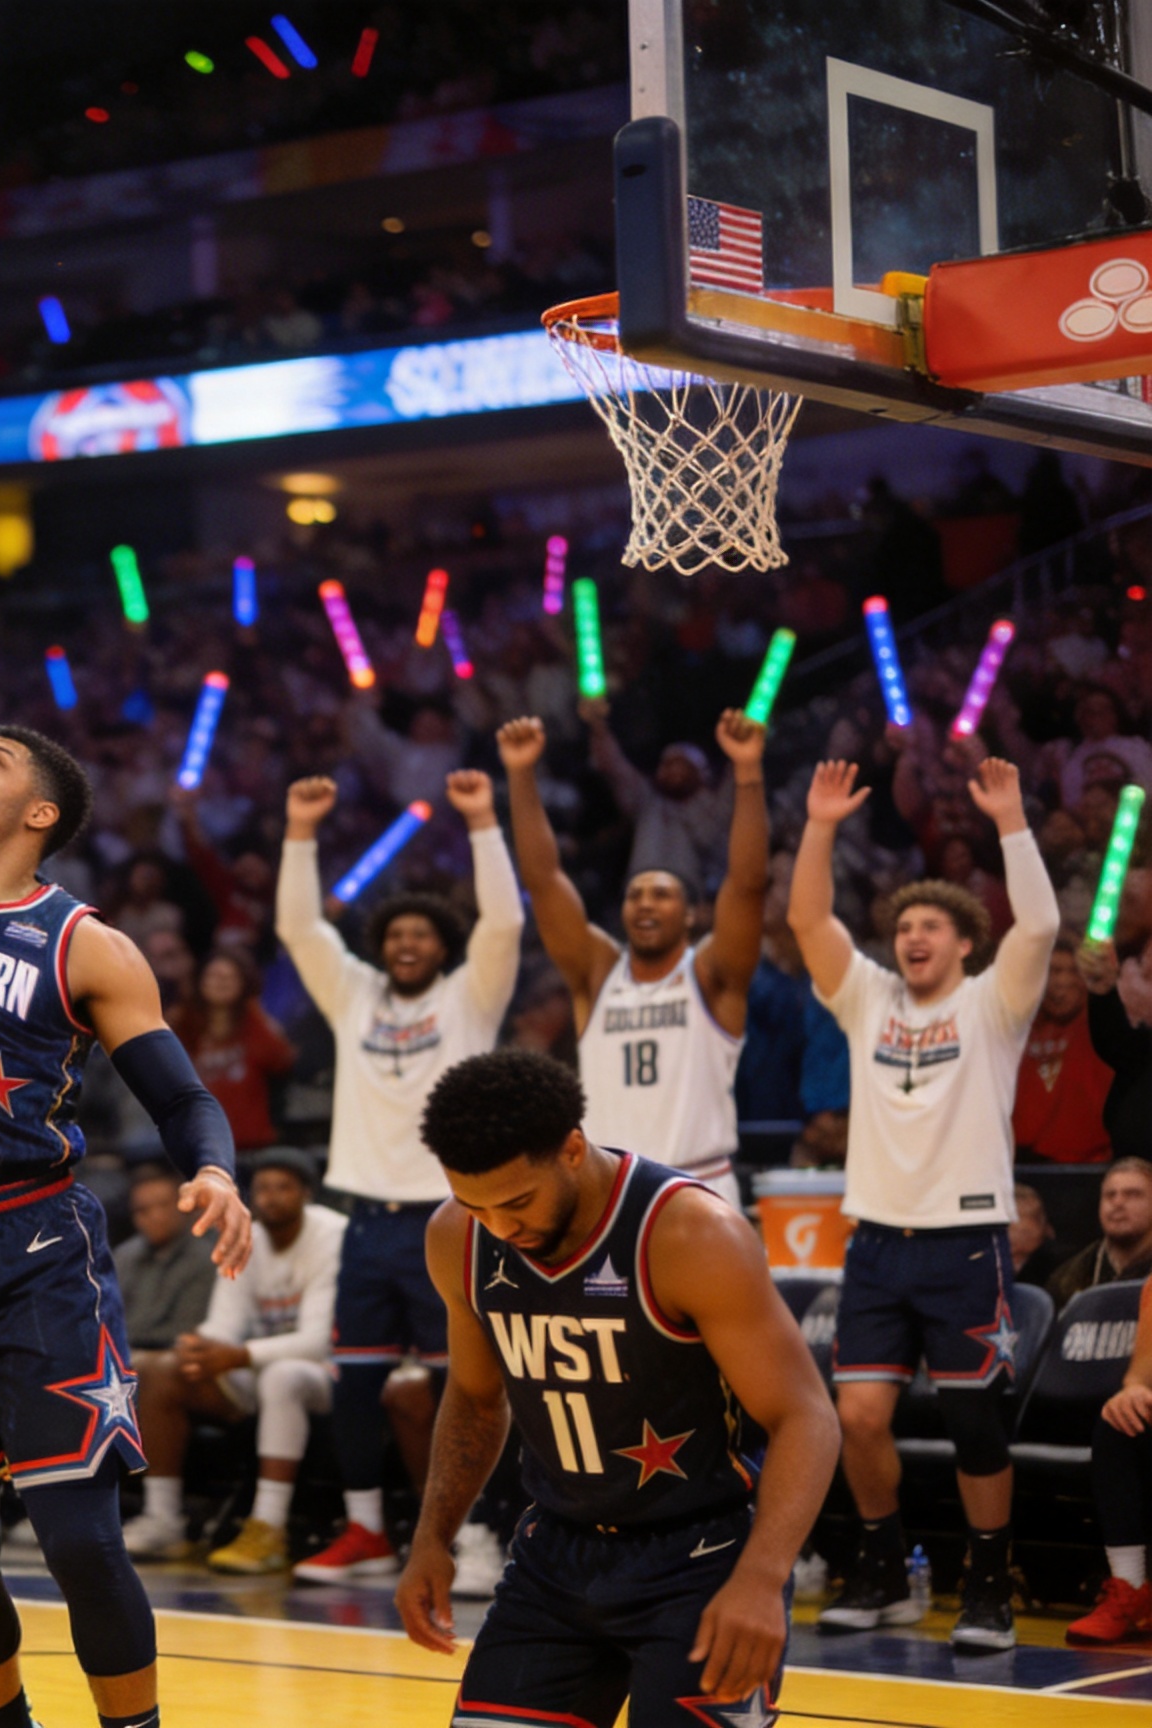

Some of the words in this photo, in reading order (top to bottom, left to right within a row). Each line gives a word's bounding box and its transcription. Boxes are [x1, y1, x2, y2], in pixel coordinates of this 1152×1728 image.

[622, 1040, 659, 1087] 18
[486, 1311, 626, 1383] WST
[542, 1390, 604, 1474] 11
